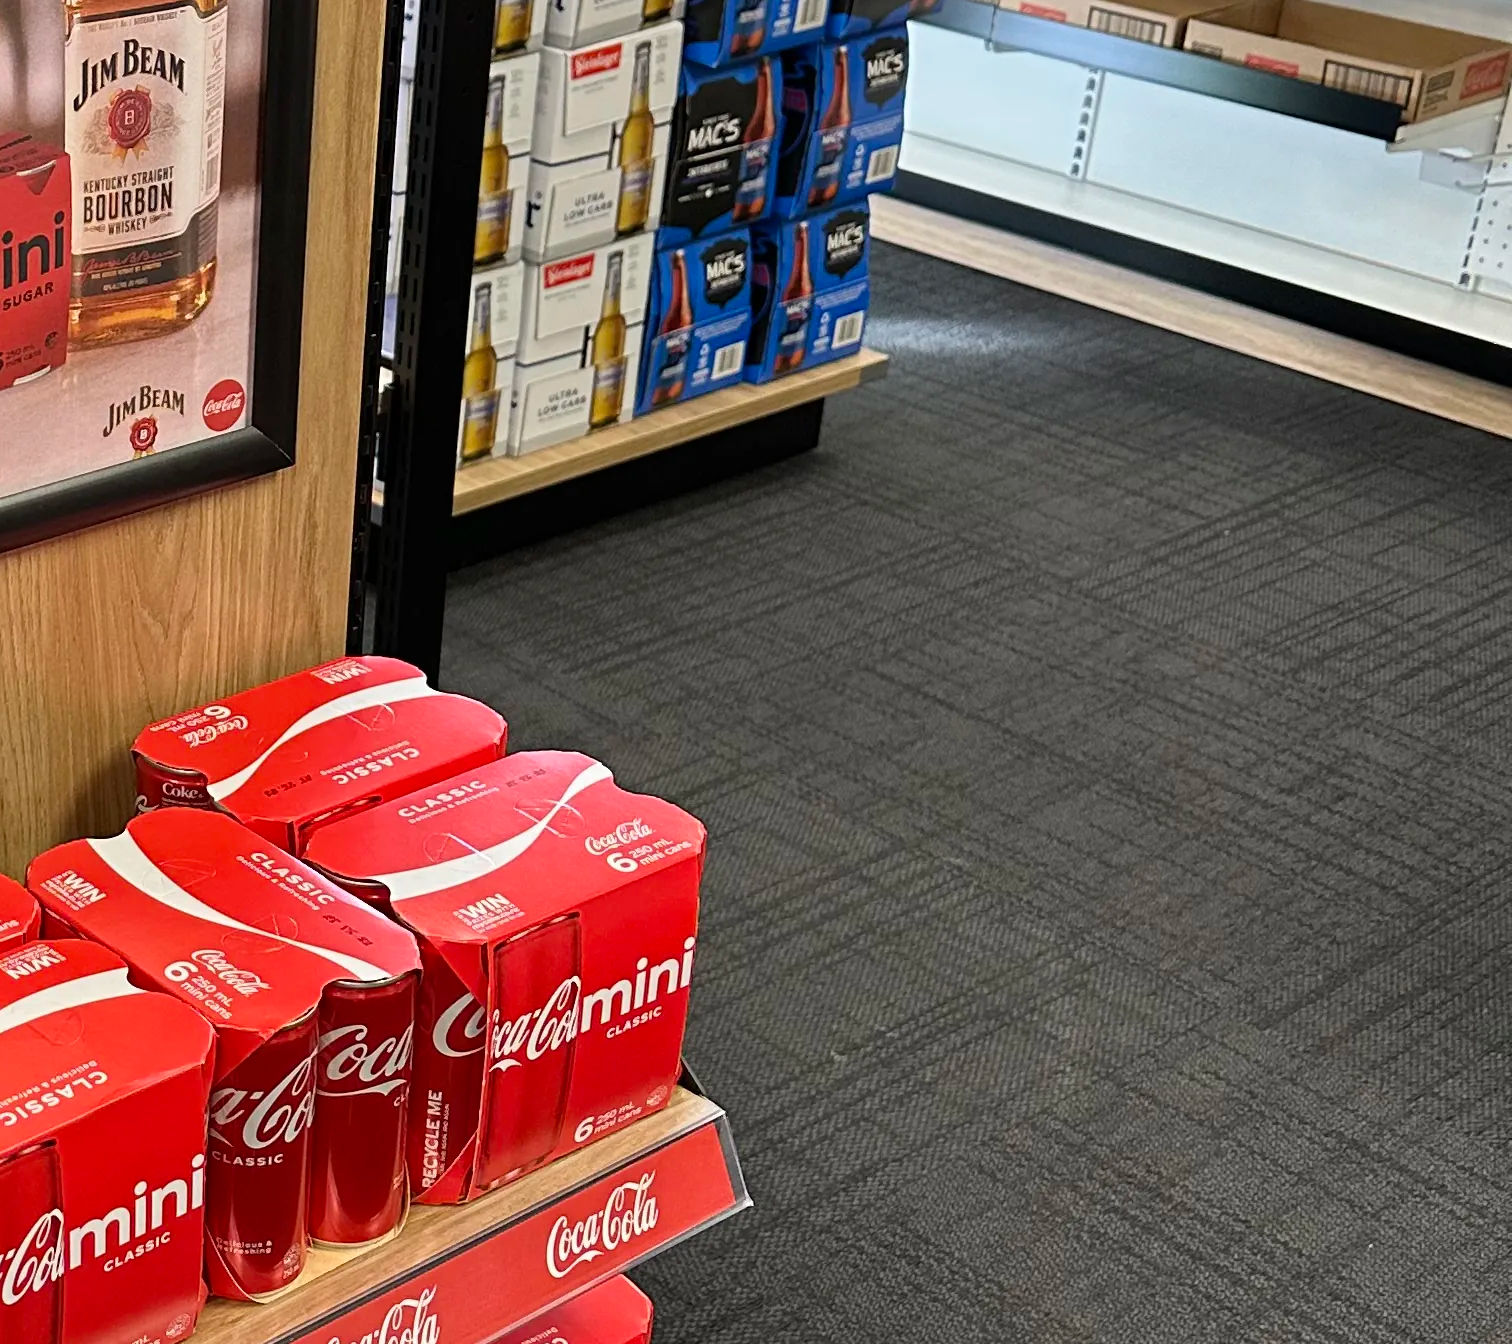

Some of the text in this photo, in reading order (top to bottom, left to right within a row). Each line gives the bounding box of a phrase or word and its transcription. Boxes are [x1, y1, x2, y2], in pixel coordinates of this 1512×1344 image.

[73, 39, 186, 112] JIM BEAM
[866, 54, 904, 78] MAC'S
[688, 117, 741, 152] MAC'S
[84, 166, 174, 193] KENTUCKY STRAIGHT
[84, 182, 173, 224] BOURBON
[564, 208, 586, 221] LOW
[574, 192, 605, 206] ULTRA
[109, 217, 148, 236] WHISKEY
[827, 225, 864, 250] MAC'S
[706, 253, 746, 280] MAC'S
[3, 282, 54, 311] SUGAR
[103, 385, 184, 437] JIM BEAM
[331, 747, 420, 785] CLASSIC
[162, 782, 199, 799] Coke
[397, 780, 487, 818] CLASSIC
[585, 819, 653, 855] Coca-Cola
[250, 851, 336, 906] CLASSIC
[607, 853, 638, 873] 6
[64, 873, 107, 902] WIN
[458, 893, 511, 918] WIN
[5, 953, 59, 980] WIN
[164, 961, 199, 982] 6
[191, 949, 271, 999] Coca-Cola
[180, 980, 233, 1020] mini cans
[191, 975, 233, 1007] 250 mL
[581, 937, 695, 1033] mini
[606, 1007, 662, 1039] CLASSIC
[422, 1089, 443, 1189] RECYCLE ME
[574, 1116, 594, 1143] 6
[212, 1150, 284, 1167] CLASSIC
[69, 1153, 205, 1270] mini
[547, 1170, 659, 1279] Coca-Cola
[103, 1231, 172, 1273] CLASSIC
